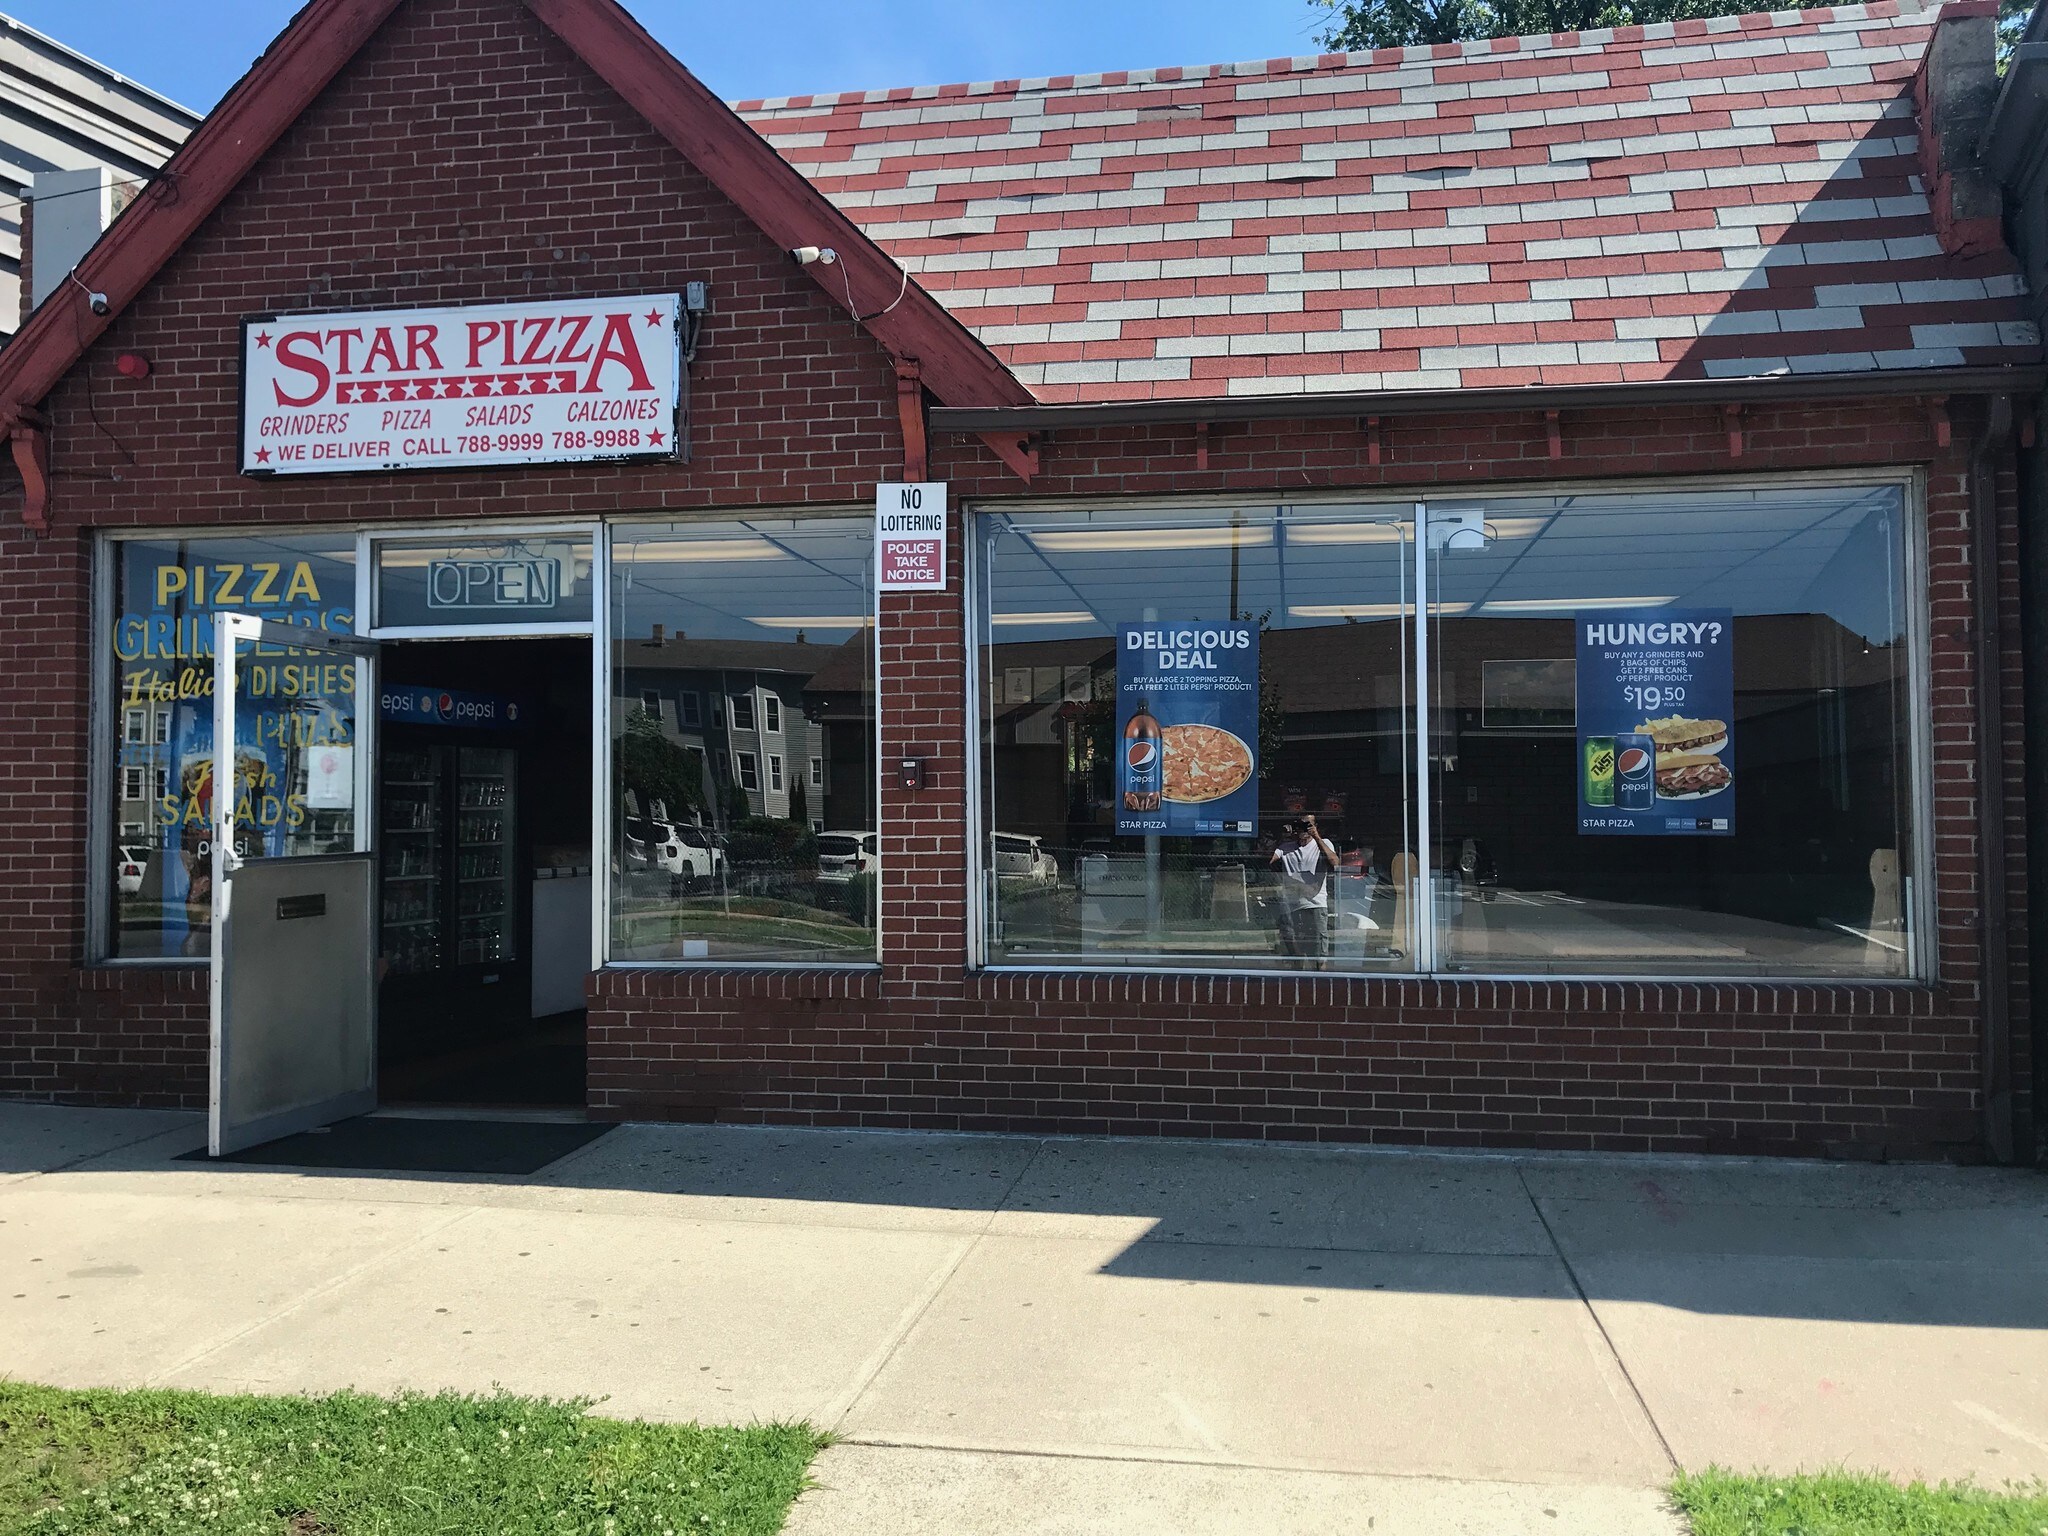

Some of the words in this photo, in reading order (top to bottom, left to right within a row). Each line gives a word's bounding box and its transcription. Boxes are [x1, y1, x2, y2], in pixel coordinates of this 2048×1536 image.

[273, 324, 443, 408] STAR
[465, 313, 655, 393] PIZZA
[260, 412, 349, 438] GRINDERS
[382, 408, 432, 432] PIZZA
[466, 403, 534, 428] SALADS
[567, 398, 660, 423] CALZONES
[278, 444, 306, 461] WE
[312, 440, 390, 460] DELIVER
[403, 438, 452, 456] CALL
[457, 432, 544, 454] 788-9999
[552, 428, 640, 451] 788-9988
[901, 488, 922, 510] NO
[881, 515, 942, 531] LOITERING
[887, 543, 935, 554] POLICE
[894, 556, 928, 567] TAKE
[434, 562, 549, 603] OPEN
[887, 569, 935, 580] NOTICE
[155, 562, 321, 608] PIZZA
[1126, 630, 1250, 650] DELICIOUS
[1586, 622, 1722, 646] HUNGRY?
[1159, 651, 1218, 669] DEAL
[1662, 659, 1688, 667] CHIPS,
[252, 664, 355, 696] DISHES
[1214, 683, 1252, 691] PRODUCT!
[381, 693, 414, 714] epsi
[456, 701, 495, 720] pepsi
[1623, 685, 1686, 710] $19.50
[1130, 774, 1155, 784] pepsi
[1621, 782, 1649, 792] pepsi
[1120, 820, 1141, 829] STAR
[1143, 820, 1167, 829] PIZZA
[1582, 819, 1606, 828] STAR
[1608, 819, 1635, 828] PIZZA
